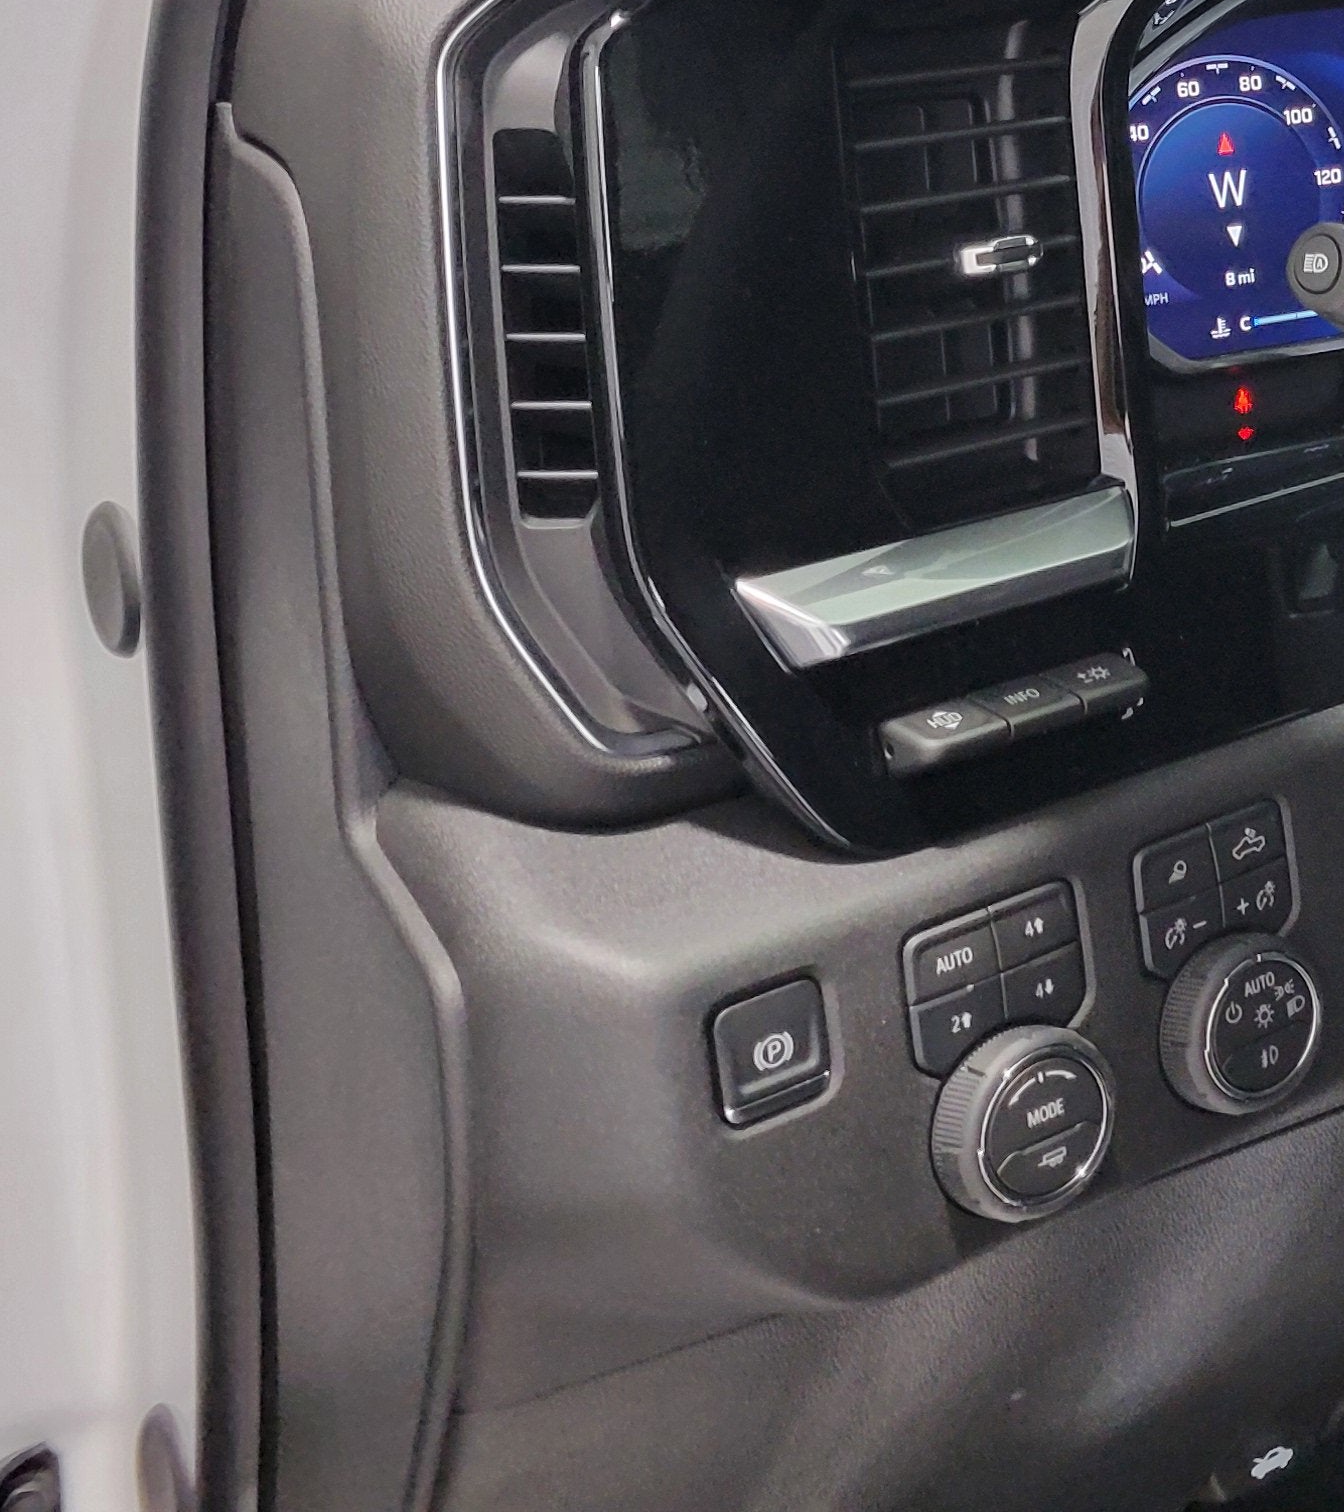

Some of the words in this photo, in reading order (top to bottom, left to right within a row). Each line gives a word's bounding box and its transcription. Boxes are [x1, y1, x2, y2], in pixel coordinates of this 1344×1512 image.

[1177, 81, 1200, 98] 60
[1238, 75, 1262, 92] 80
[1283, 107, 1313, 126] 100
[1314, 168, 1342, 186] 120
[1207, 168, 1247, 208] W
[1225, 271, 1236, 287] 8
[1237, 267, 1255, 285] mi
[1239, 315, 1252, 332] C
[1003, 687, 1041, 706] INFO
[926, 711, 964, 730] HUD
[935, 946, 974, 975] AUTO
[1244, 970, 1276, 998] AUTO
[950, 1014, 961, 1034] 2
[766, 1040, 782, 1063] P
[1026, 1097, 1066, 1130] MODE
